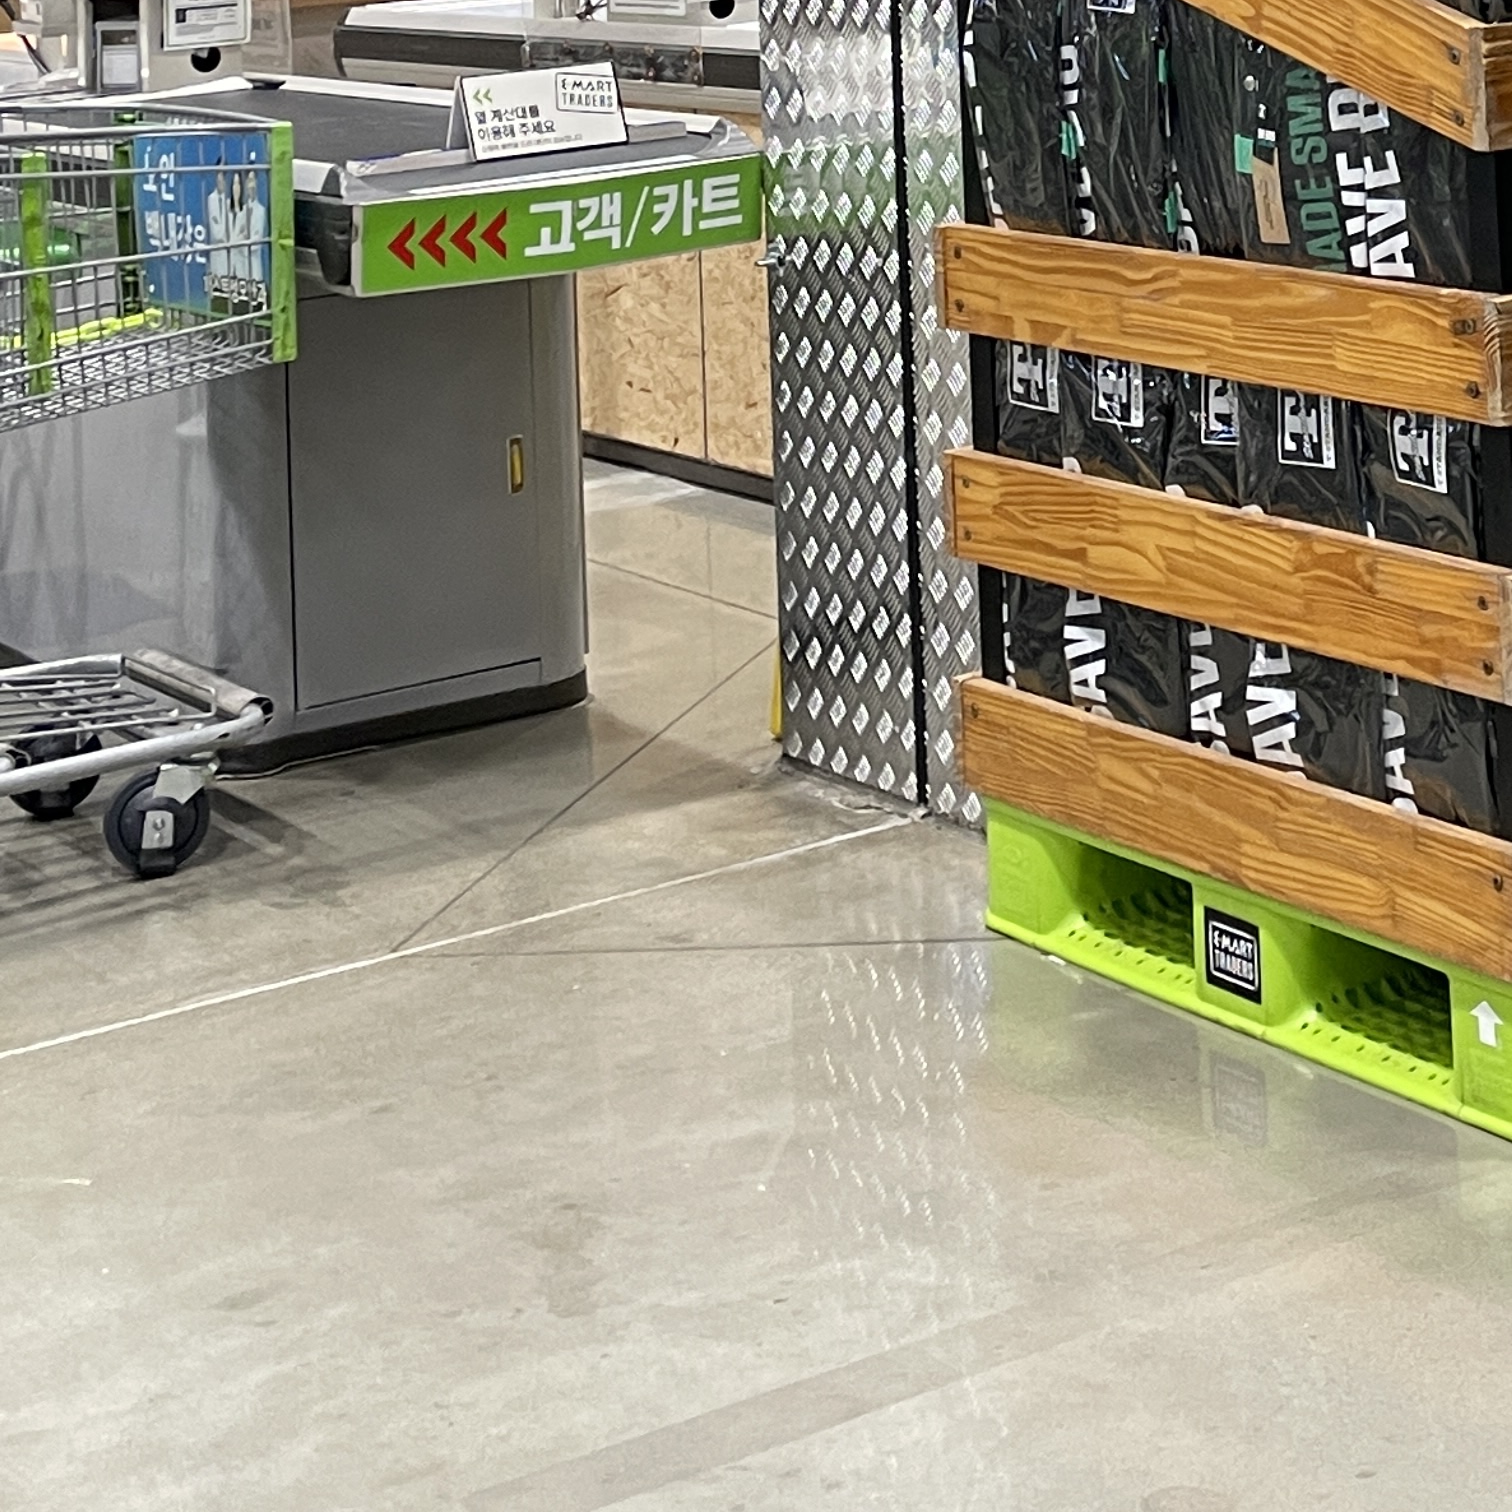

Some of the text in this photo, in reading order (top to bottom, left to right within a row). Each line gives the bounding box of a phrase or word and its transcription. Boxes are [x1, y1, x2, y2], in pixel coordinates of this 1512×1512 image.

[562, 92, 614, 108] TRADERS
[477, 120, 557, 142] 이용해 주세요
[523, 173, 743, 258] 고객/카트
[1214, 948, 1253, 981] TRADERS
